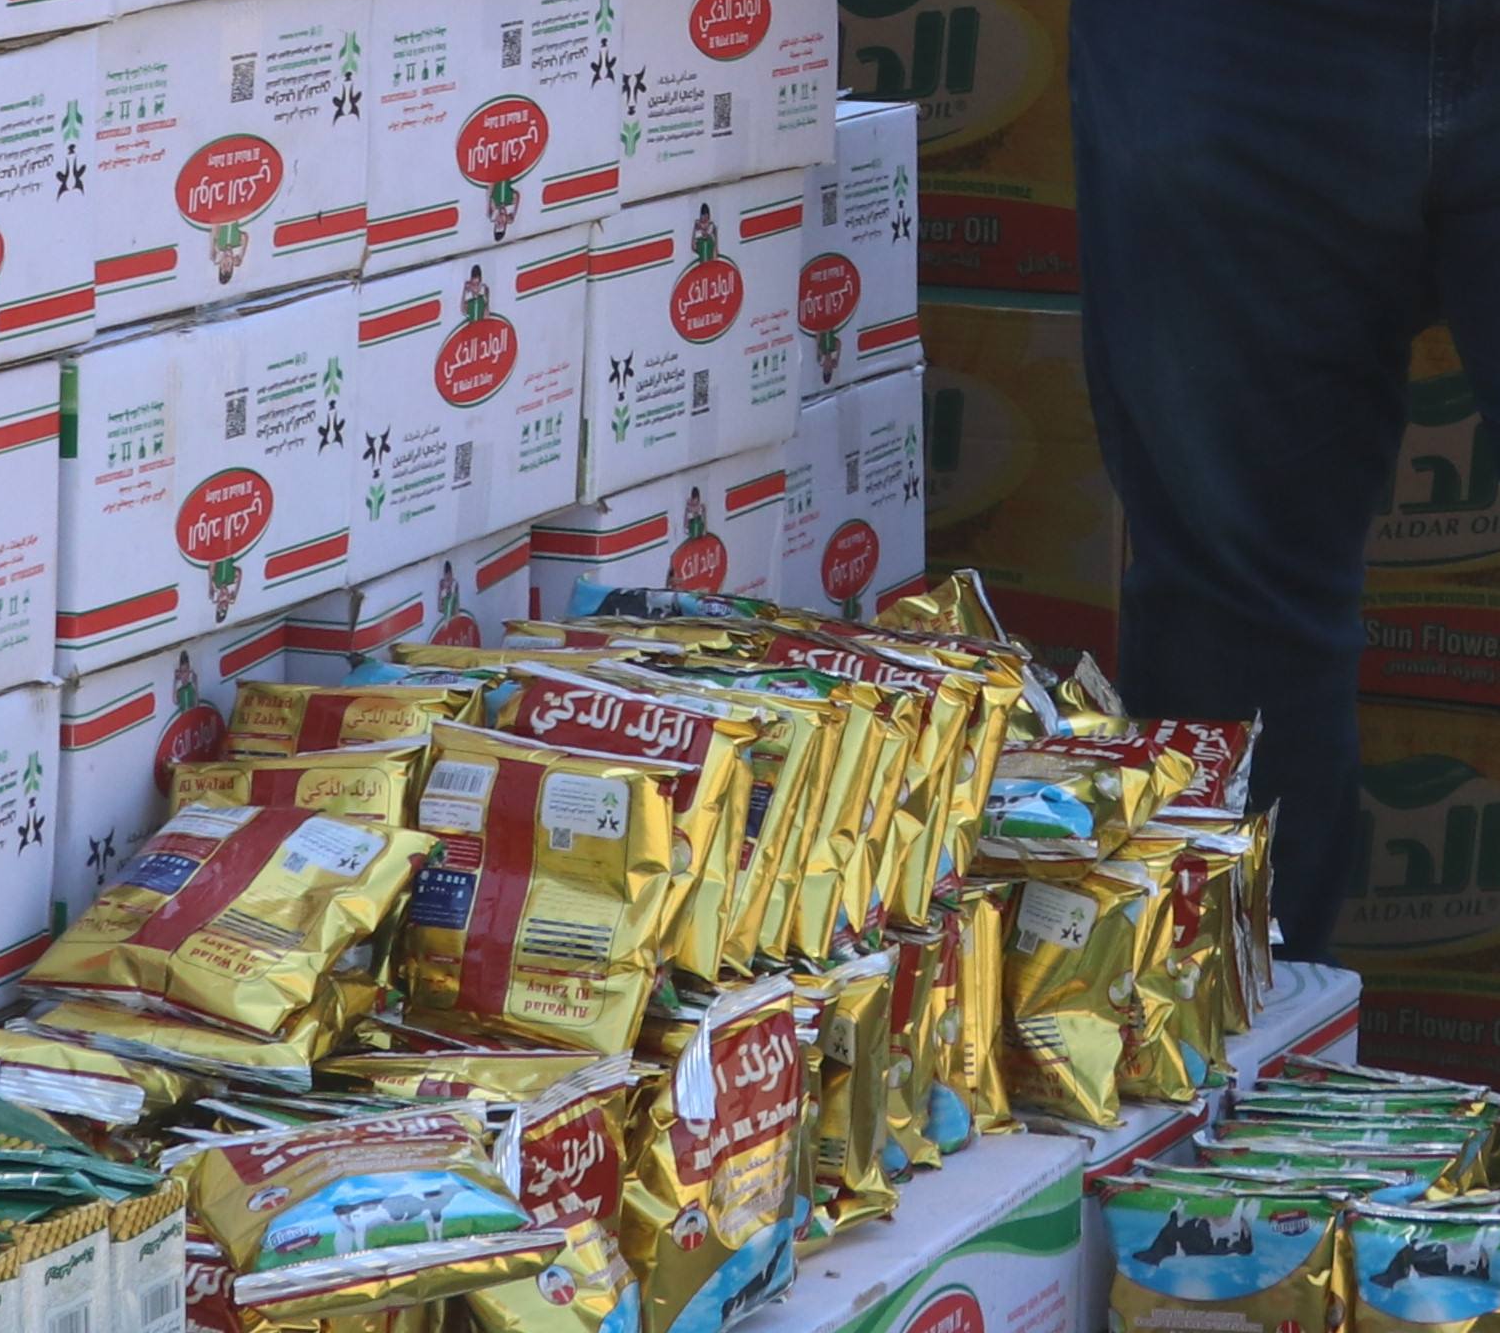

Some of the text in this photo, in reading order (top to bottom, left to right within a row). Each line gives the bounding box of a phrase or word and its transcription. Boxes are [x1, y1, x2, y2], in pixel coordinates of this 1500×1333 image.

[467, 120, 538, 173] الولد الذكي
[188, 159, 270, 213] الولد الذكي
[189, 491, 262, 551] الولد الذكي
[1377, 518, 1459, 539] ALDAR
[1365, 619, 1413, 649] Sun
[1353, 900, 1485, 924] ALDAR OIL
[524, 999, 589, 1018] Al Walad
[1361, 1008, 1388, 1032] un
[1400, 1009, 1484, 1040] Flower
